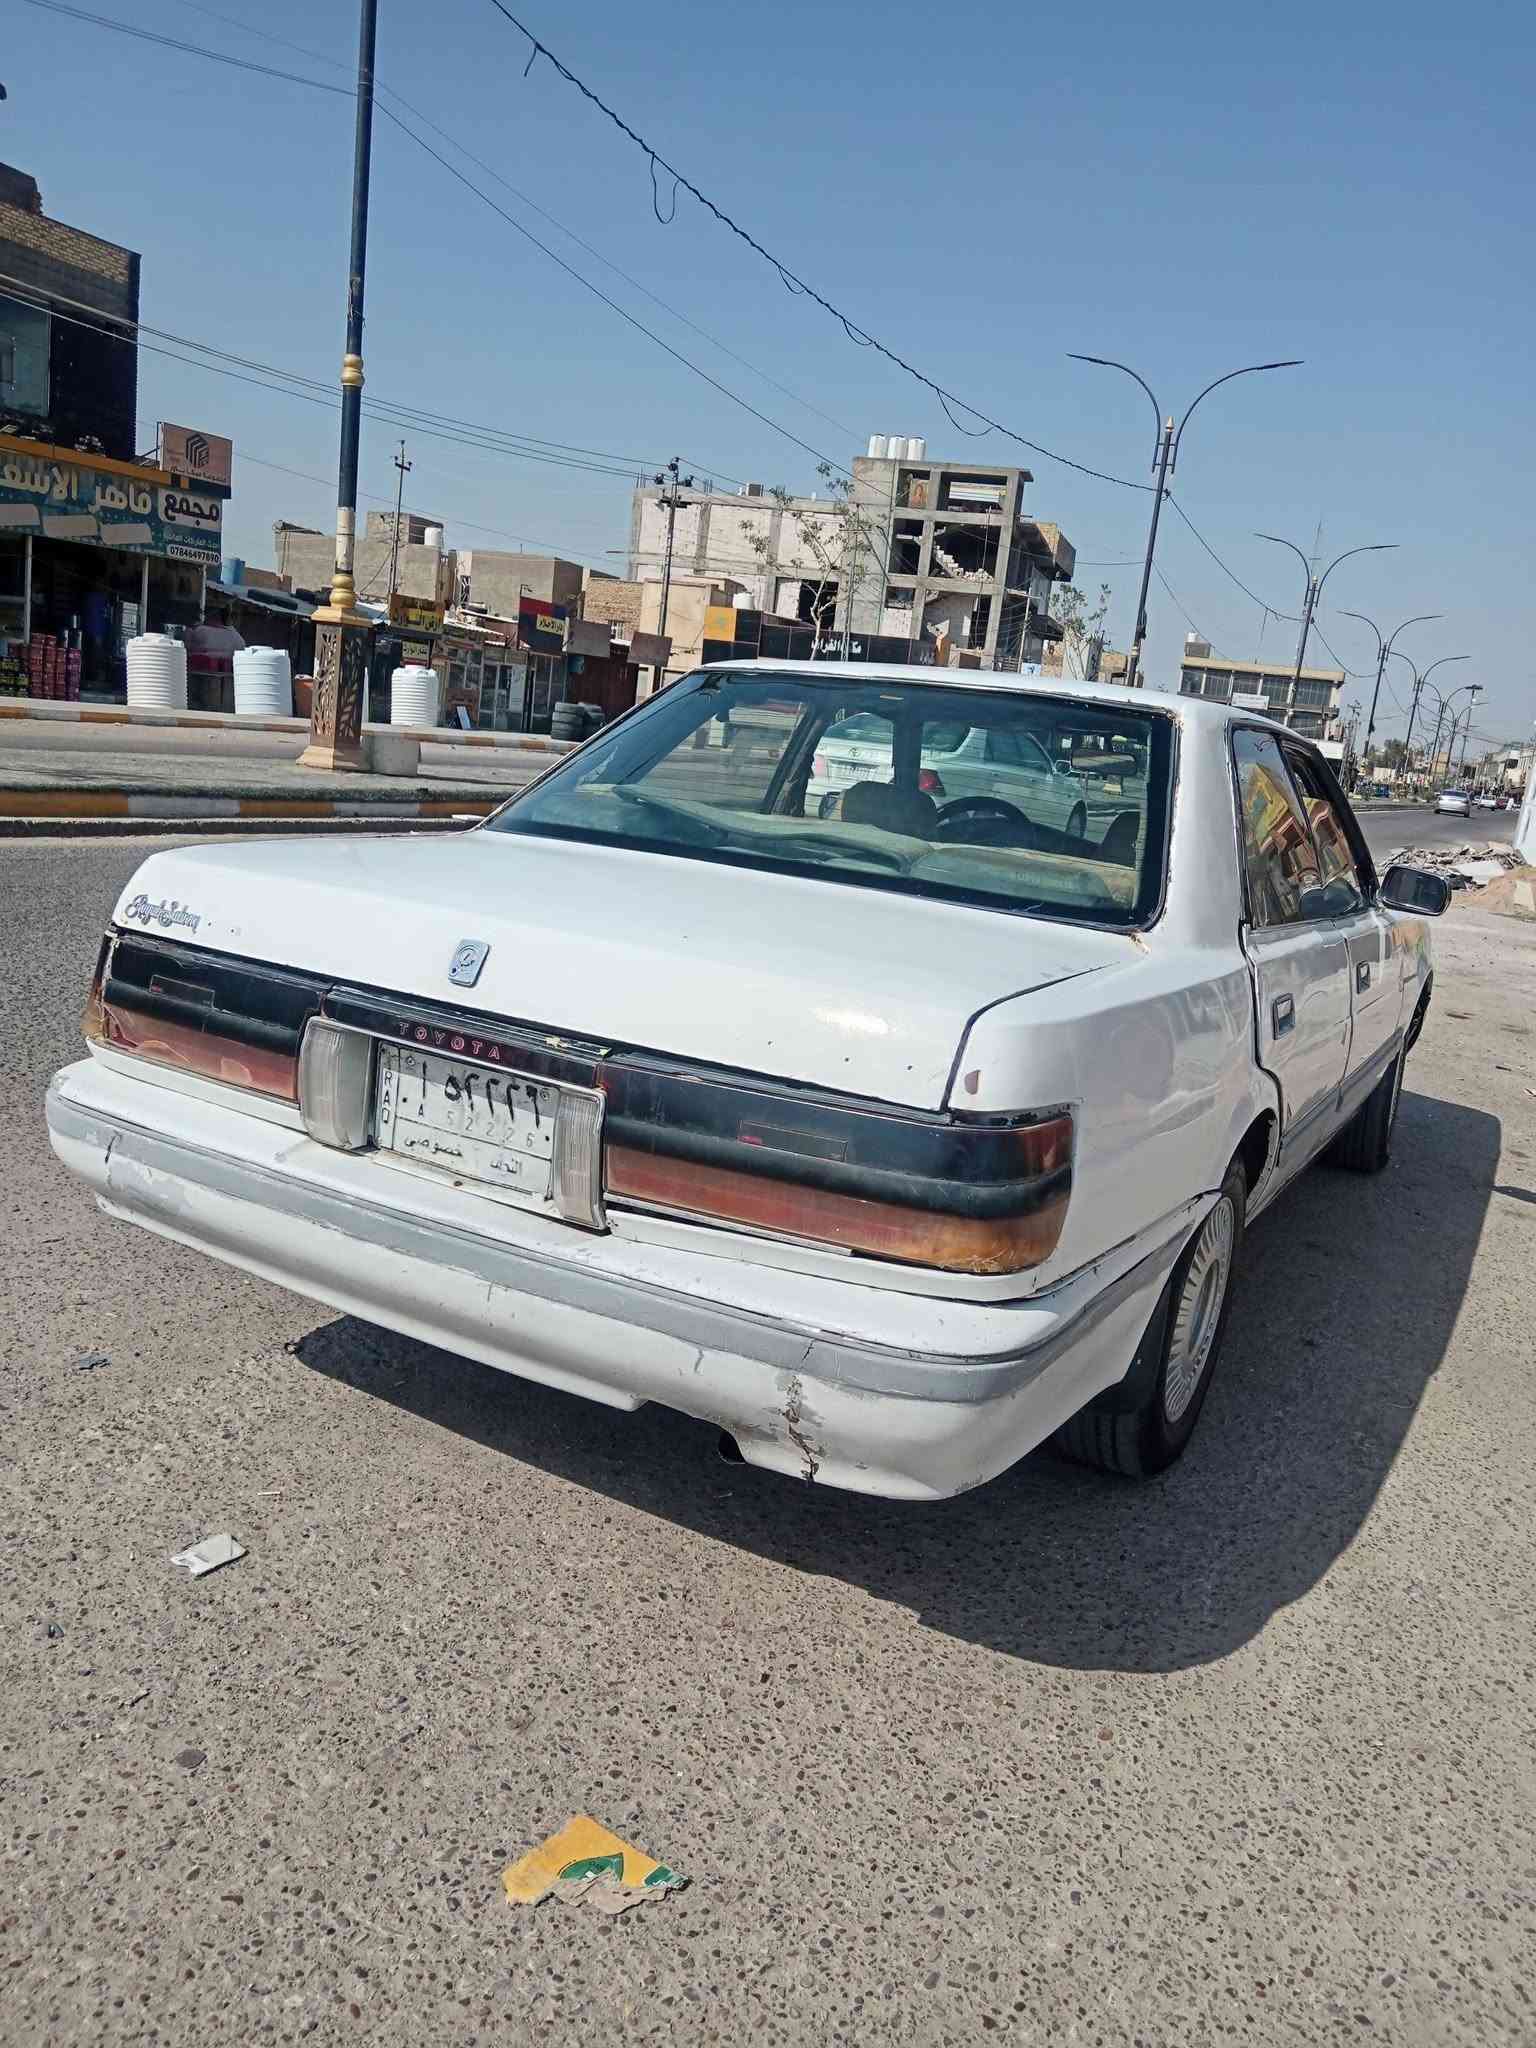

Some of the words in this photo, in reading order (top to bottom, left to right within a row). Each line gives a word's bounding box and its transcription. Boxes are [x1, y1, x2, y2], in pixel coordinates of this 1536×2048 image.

[88, 481, 152, 514] قاهر
[164, 494, 220, 527] مجمع
[399, 1021, 500, 1060] TOYOTA
[417, 1103, 425, 1118] A
[446, 1110, 536, 1148] 52226
